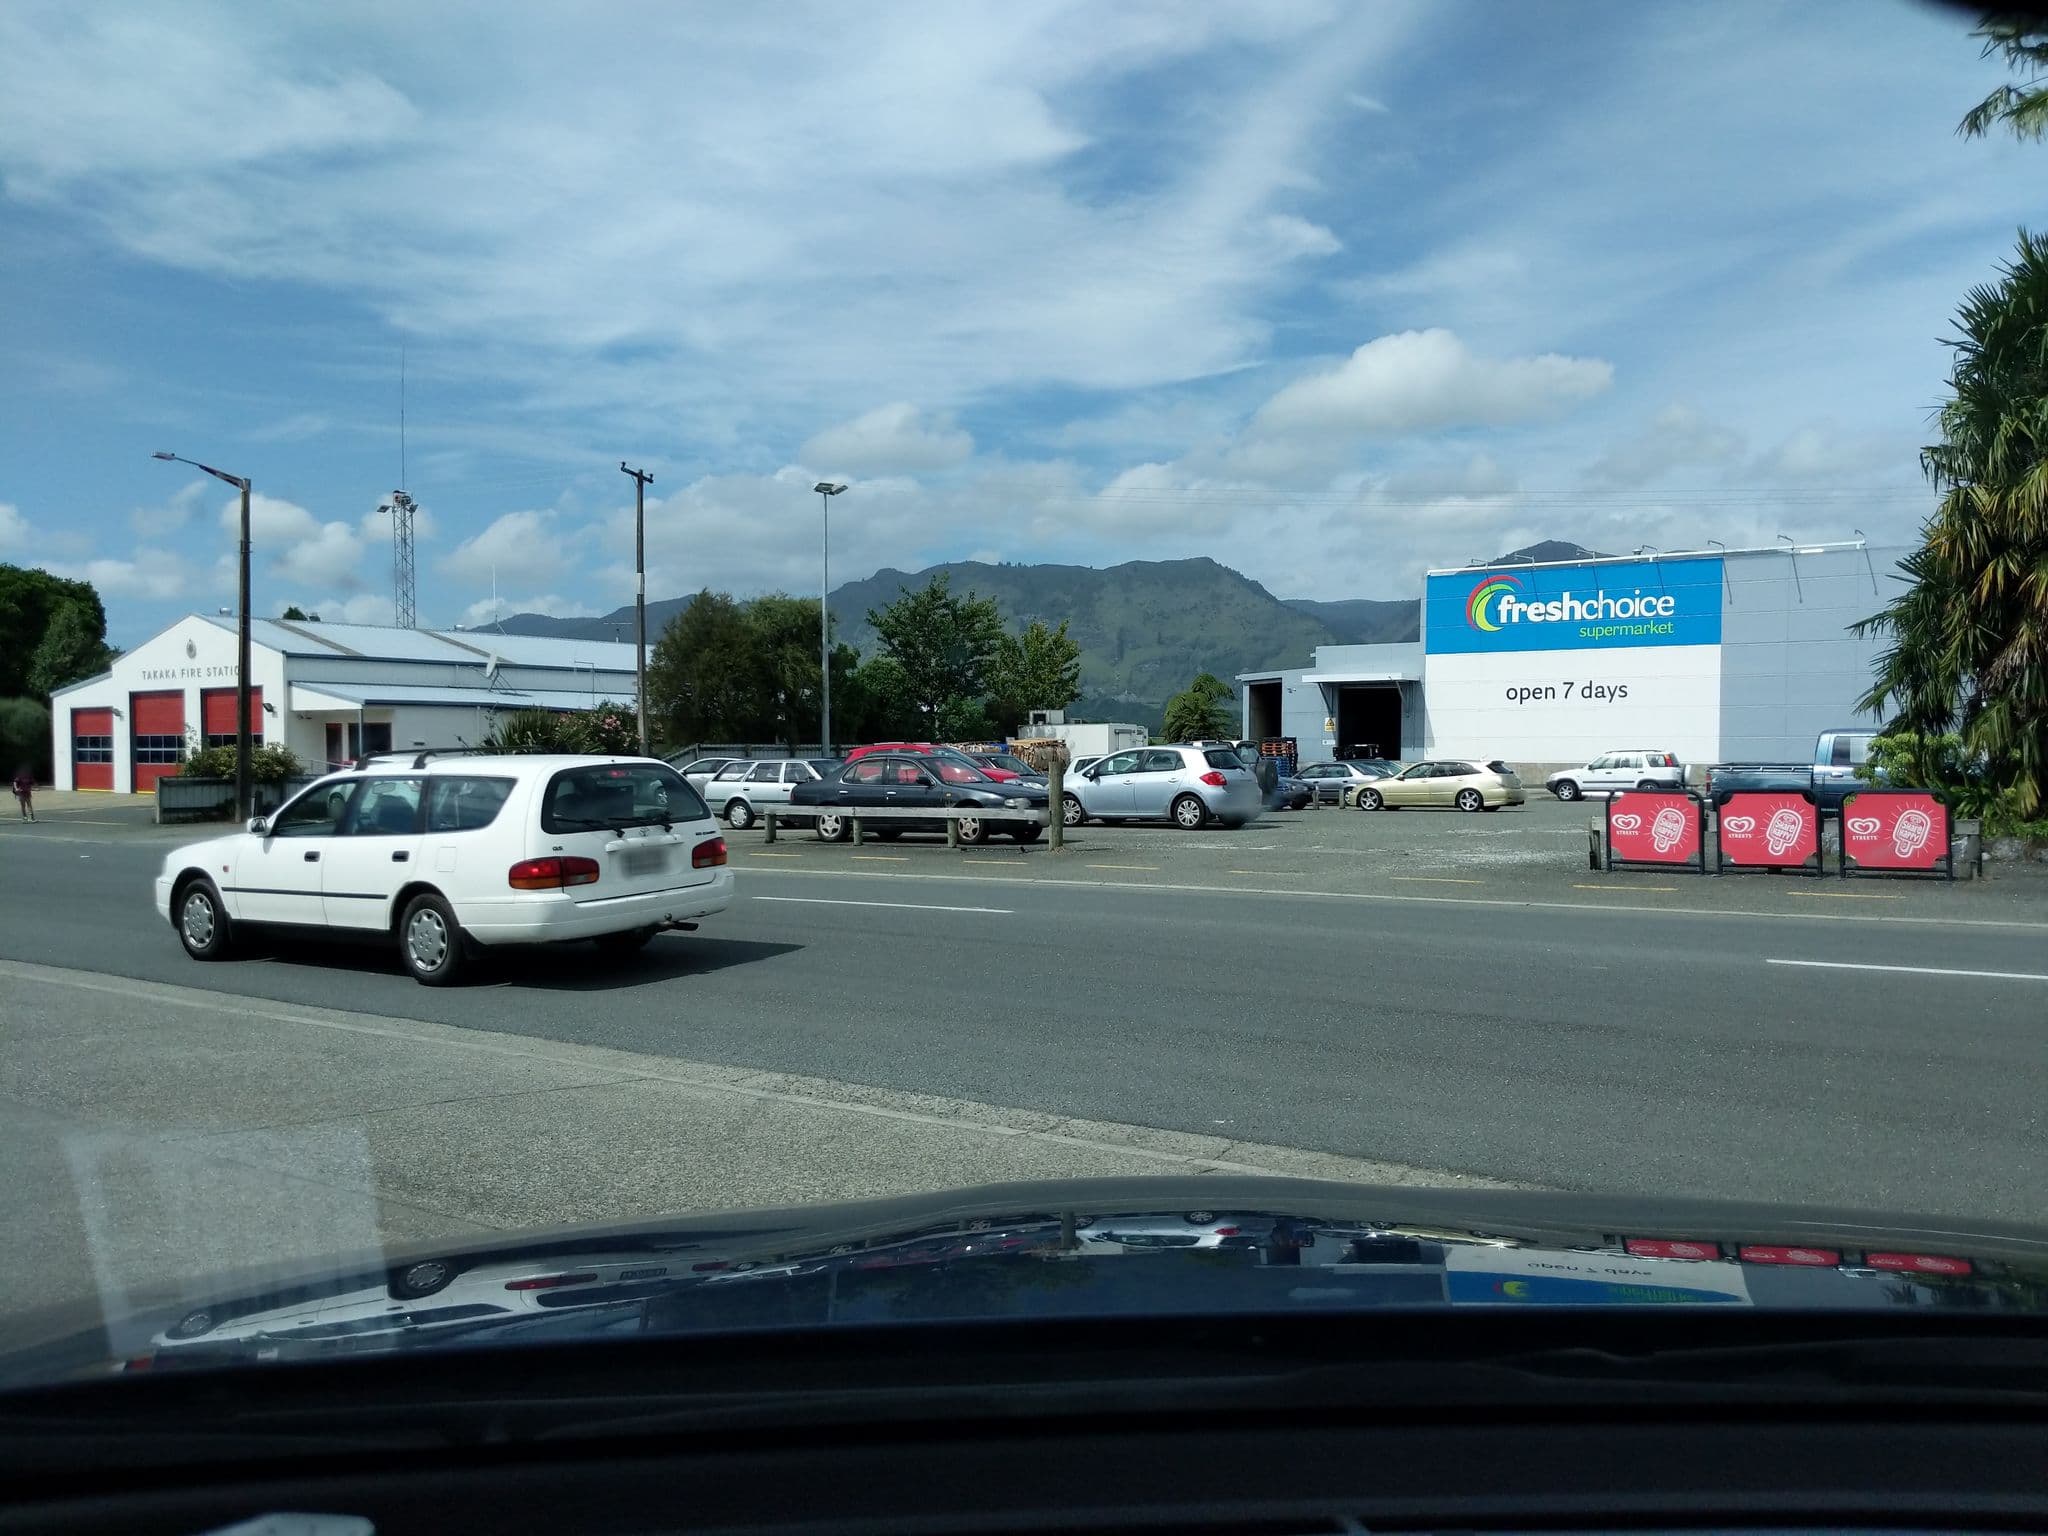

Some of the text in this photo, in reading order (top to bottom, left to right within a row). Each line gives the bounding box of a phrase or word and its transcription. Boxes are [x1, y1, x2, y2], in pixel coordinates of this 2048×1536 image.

[1498, 589, 1675, 624] freshchoice
[1579, 620, 1675, 640] supermarket
[142, 665, 240, 680] TAKAKA FIRE STATIO
[1506, 680, 1628, 705] open 7 days
